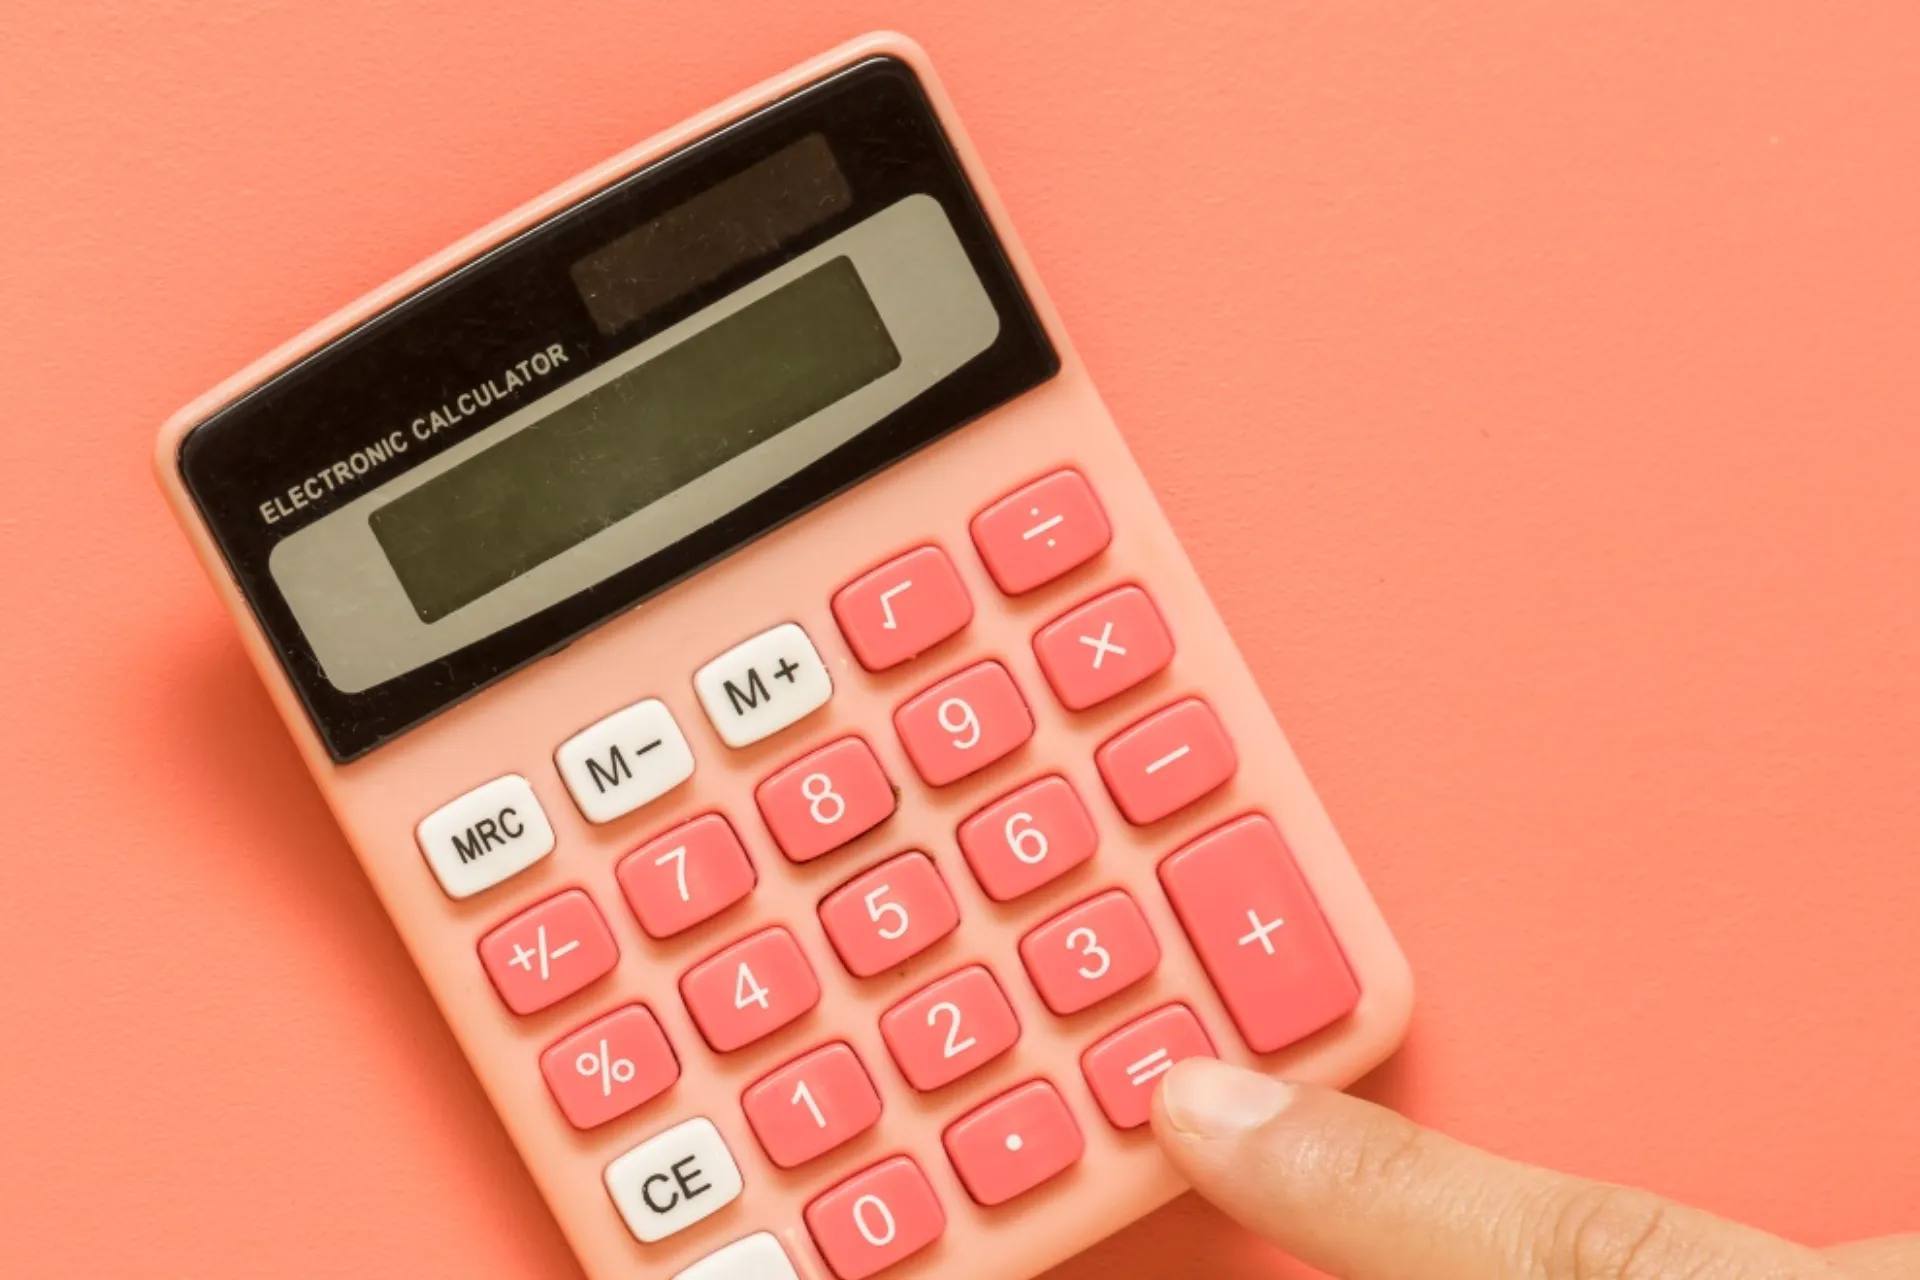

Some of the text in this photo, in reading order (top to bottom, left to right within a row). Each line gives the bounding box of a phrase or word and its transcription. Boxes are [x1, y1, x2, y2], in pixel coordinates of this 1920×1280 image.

[259, 343, 569, 525] ELECTRONIC CALCULATOR
[722, 657, 800, 716] M+
[938, 697, 981, 749] 9
[801, 773, 845, 824] 8
[451, 807, 525, 864] MRC
[1005, 811, 1048, 864] 6
[655, 846, 689, 901] 7
[864, 884, 909, 939] 5
[1066, 927, 1111, 979] 3
[734, 962, 769, 1010] 4
[927, 1001, 976, 1058] 2
[575, 1039, 635, 1097] %
[791, 1080, 826, 1128] 1
[641, 1154, 712, 1215] CE
[853, 1194, 896, 1246] 0
